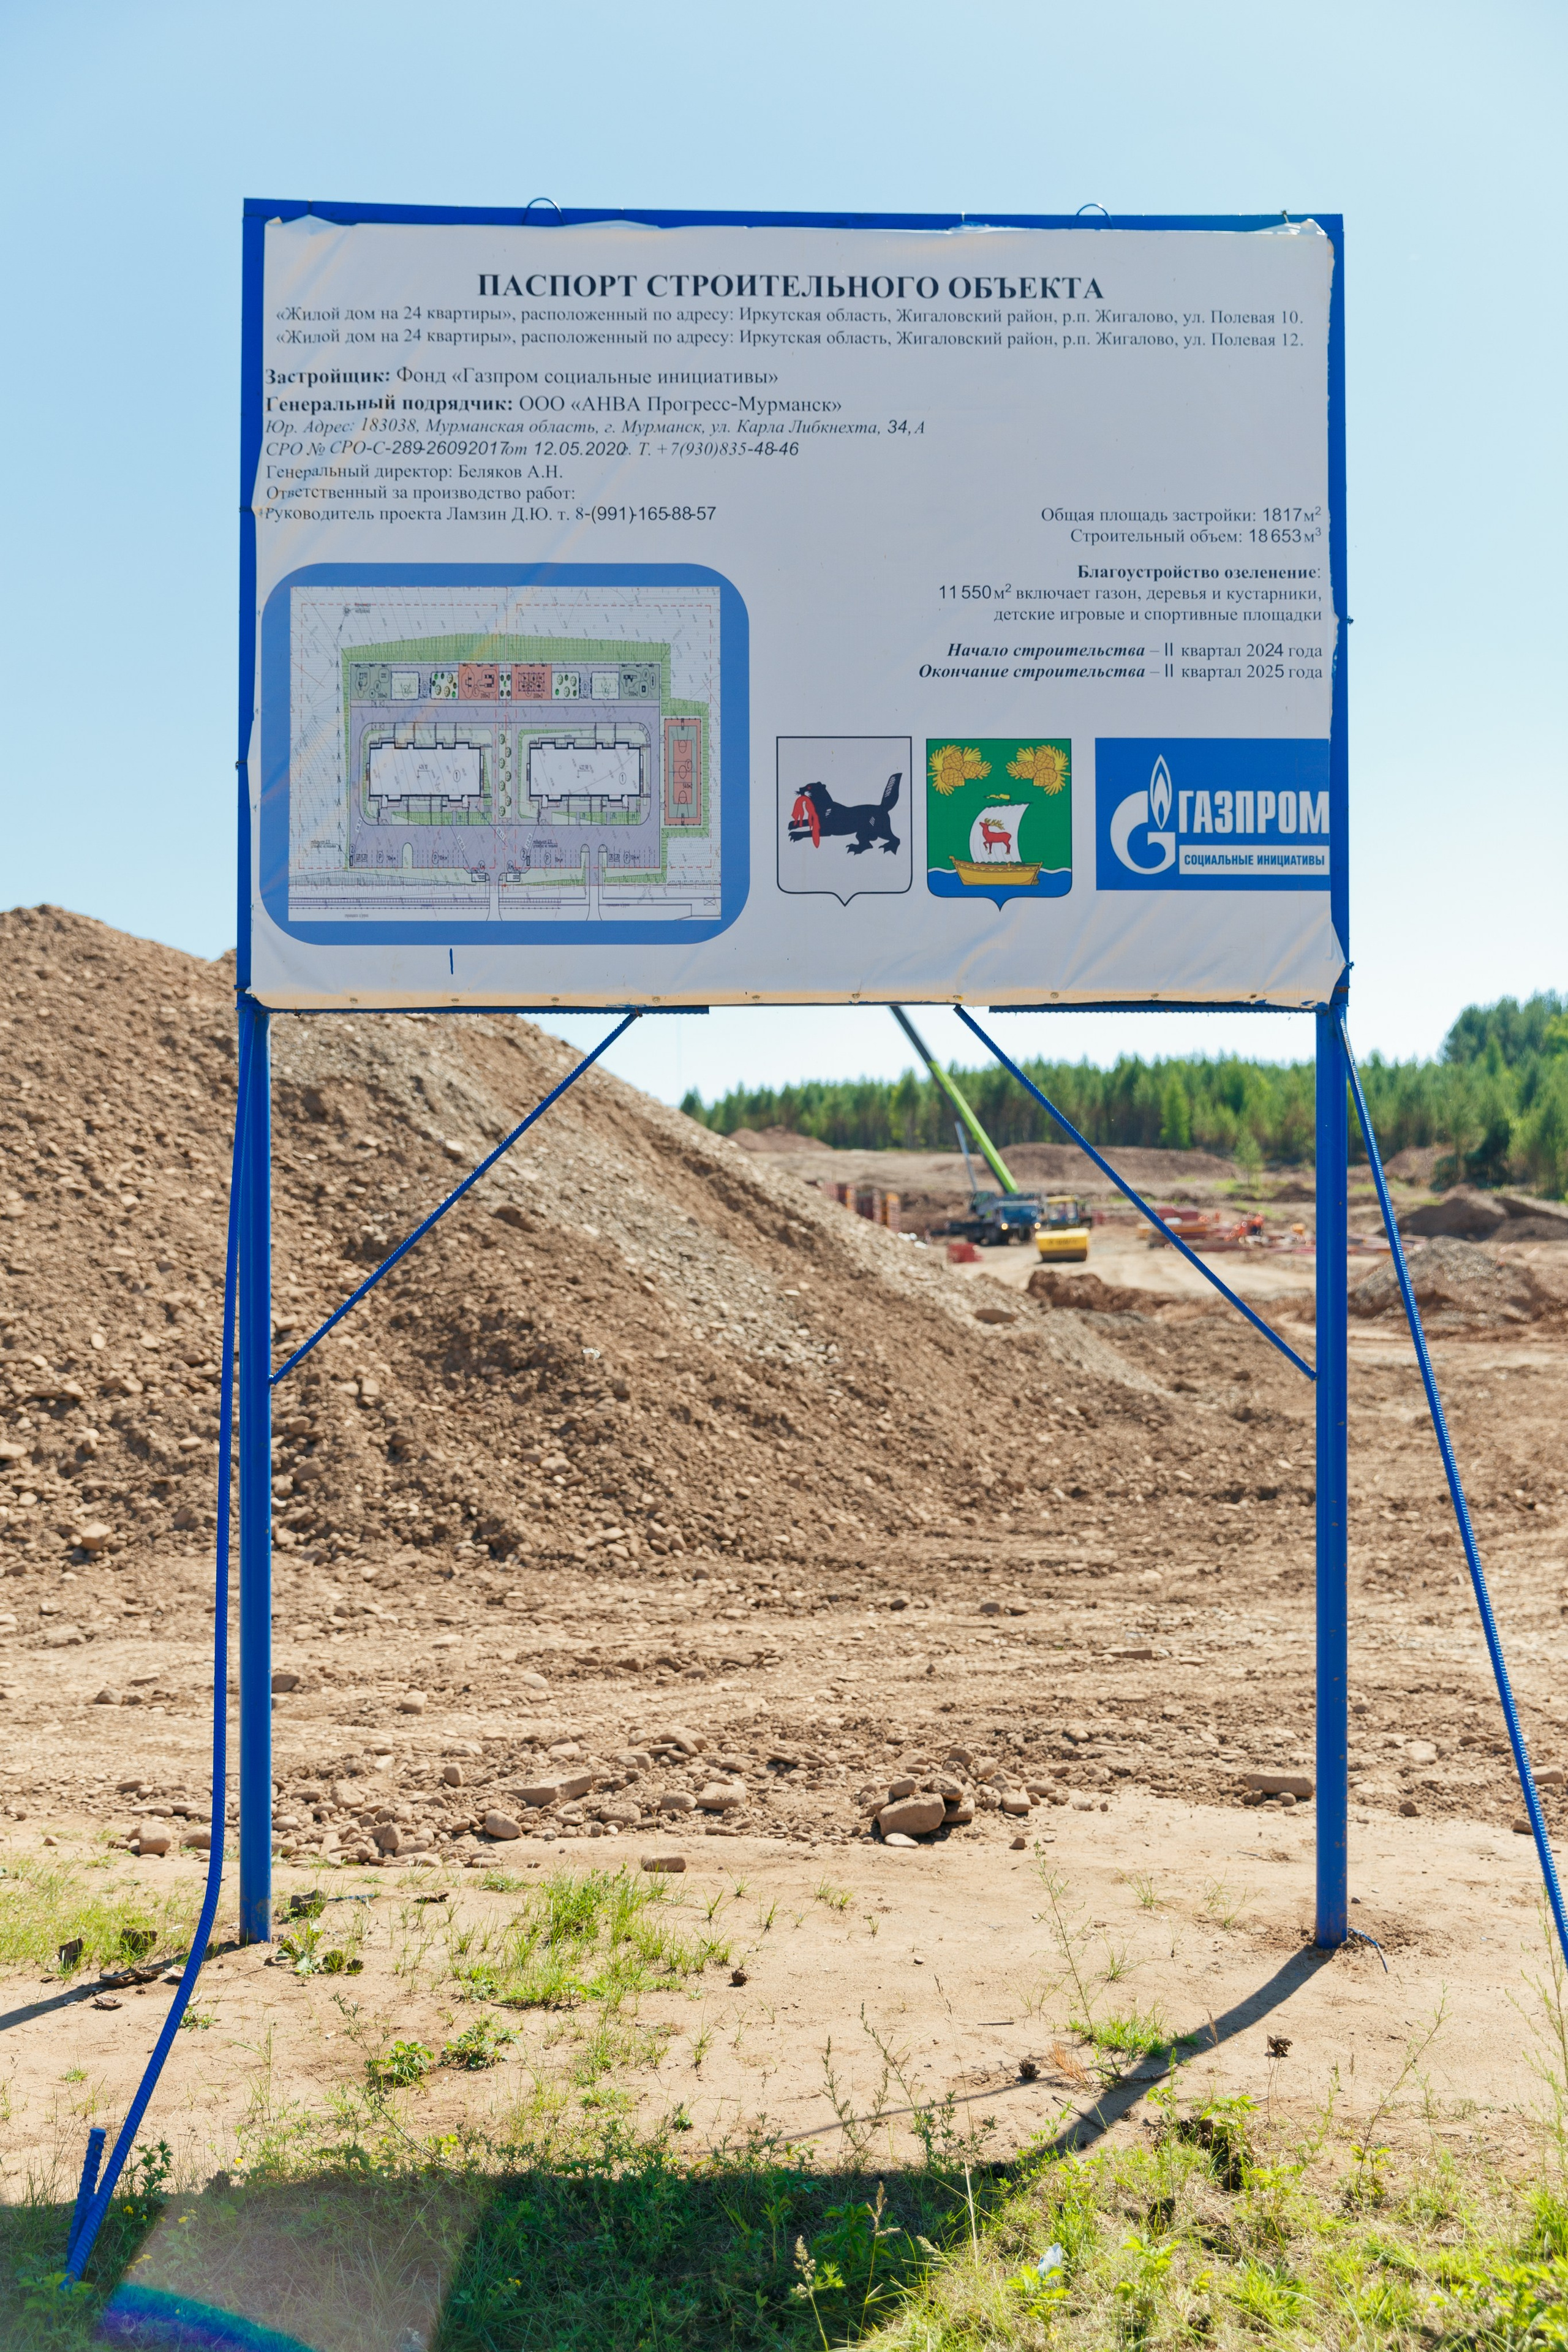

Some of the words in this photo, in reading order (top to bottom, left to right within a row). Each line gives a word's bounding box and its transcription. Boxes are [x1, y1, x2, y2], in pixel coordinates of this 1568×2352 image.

[477, 273, 638, 298] ПАСПОРТ
[646, 274, 940, 300] СТРОИТЕЛЬНОГО
[948, 276, 1105, 300] ОБЪЕКТА
[276, 306, 340, 322] «Жилой
[344, 309, 375, 321] дом
[380, 309, 399, 320] на
[403, 306, 422, 320] 24
[427, 309, 516, 324] квартиры»,
[521, 307, 647, 325] расположенный
[653, 311, 672, 322] по
[676, 310, 733, 325] адресу:
[739, 306, 821, 325] Иркутская
[826, 307, 892, 325] область,
[896, 308, 1002, 323] Жигаловский
[1007, 309, 1058, 326] район,
[1063, 312, 1090, 326] р.п.
[1095, 309, 1178, 326] Жигалово,
[1183, 313, 1205, 327] ул.
[1211, 309, 1275, 324] Полевая
[1283, 310, 1303, 324] 10.
[276, 328, 340, 344] «Жилой
[345, 332, 375, 344] дом
[381, 332, 399, 343] на
[404, 328, 422, 342] 24
[427, 331, 516, 347] квартиры»,
[521, 330, 647, 347] расположенный
[653, 333, 672, 344] по
[676, 333, 733, 347] адресу:
[739, 329, 821, 347] Иркутская
[826, 330, 892, 347] область,
[896, 331, 1002, 345] Жигаловский
[1007, 331, 1058, 349] район,
[1063, 335, 1090, 349] р.п.
[1095, 331, 1178, 348] Жигалово,
[1183, 336, 1205, 350] ул.
[1212, 332, 1276, 347] Полевая
[1283, 332, 1303, 347] 12.
[265, 368, 390, 388] Застройщик:
[396, 366, 447, 385] Фонд
[451, 367, 538, 388] «Газпром
[544, 372, 652, 386] социальные
[657, 372, 778, 386] инициативы»
[266, 394, 396, 417] Генеральный
[402, 399, 513, 415] подрядчик:
[519, 395, 565, 412] ООО
[570, 396, 641, 412] «АНВА
[647, 395, 842, 417] Прогресс-Мурманск»
[265, 419, 297, 437] Юр.
[303, 419, 355, 437] Адрес:
[361, 417, 420, 434] 183038,
[425, 418, 524, 437] Мурманская
[529, 419, 598, 435] область,
[604, 423, 616, 434] г.
[621, 419, 705, 437] Мурманск,
[709, 423, 730, 437] ул.
[736, 419, 785, 437] Карла
[788, 419, 880, 435] Либкнехта,
[266, 442, 303, 456] СРО
[306, 442, 326, 456] №
[639, 441, 651, 456] Т.
[266, 464, 369, 482] Генеральный
[374, 467, 453, 482] директор:
[458, 464, 522, 479] Беляков
[527, 464, 563, 478] А.Н.
[266, 484, 388, 500] Ответственный
[392, 488, 408, 499] за
[413, 489, 521, 503] производство
[526, 485, 575, 503] работ:
[265, 507, 375, 523] Руководитель
[379, 510, 442, 524] проекта
[446, 506, 507, 521] Ламзин
[511, 506, 552, 524] Д.Ю.
[557, 510, 570, 521] т.
[1041, 507, 1095, 523] Общая
[1099, 511, 1168, 523] площадь
[1172, 508, 1256, 526] застройки:
[1070, 528, 1185, 546] Строительный
[1189, 529, 1242, 543] объем:
[1077, 564, 1219, 582] Благоустройство
[1224, 567, 1321, 579] озеленение:
[1016, 589, 1091, 600] включает
[1095, 589, 1142, 602] газон,
[1145, 589, 1207, 604] деревья
[1212, 590, 1221, 600] и
[1226, 590, 1322, 604] кустарники,
[993, 610, 1055, 622] детские
[1060, 610, 1125, 624] игровые
[1130, 611, 1139, 620] и
[1144, 610, 1238, 625] спортивные
[1243, 611, 1322, 623] площадки
[946, 643, 1009, 657] Начало
[1012, 647, 1145, 661] строительства
[1181, 647, 1242, 661] квартал
[1246, 643, 1284, 657] 2024
[1288, 647, 1323, 659] года
[918, 663, 1009, 678] Окончание
[1012, 668, 1145, 682] строительства
[1181, 668, 1242, 682] квартал
[1246, 663, 1284, 679] 2025
[1288, 668, 1323, 680] года
[1178, 790, 1330, 834] ГАЗПРОМ
[1184, 854, 1254, 867] СОЦИАЛЬНЫЕ
[1257, 854, 1325, 867] ИНИЦИАТИВЫ
